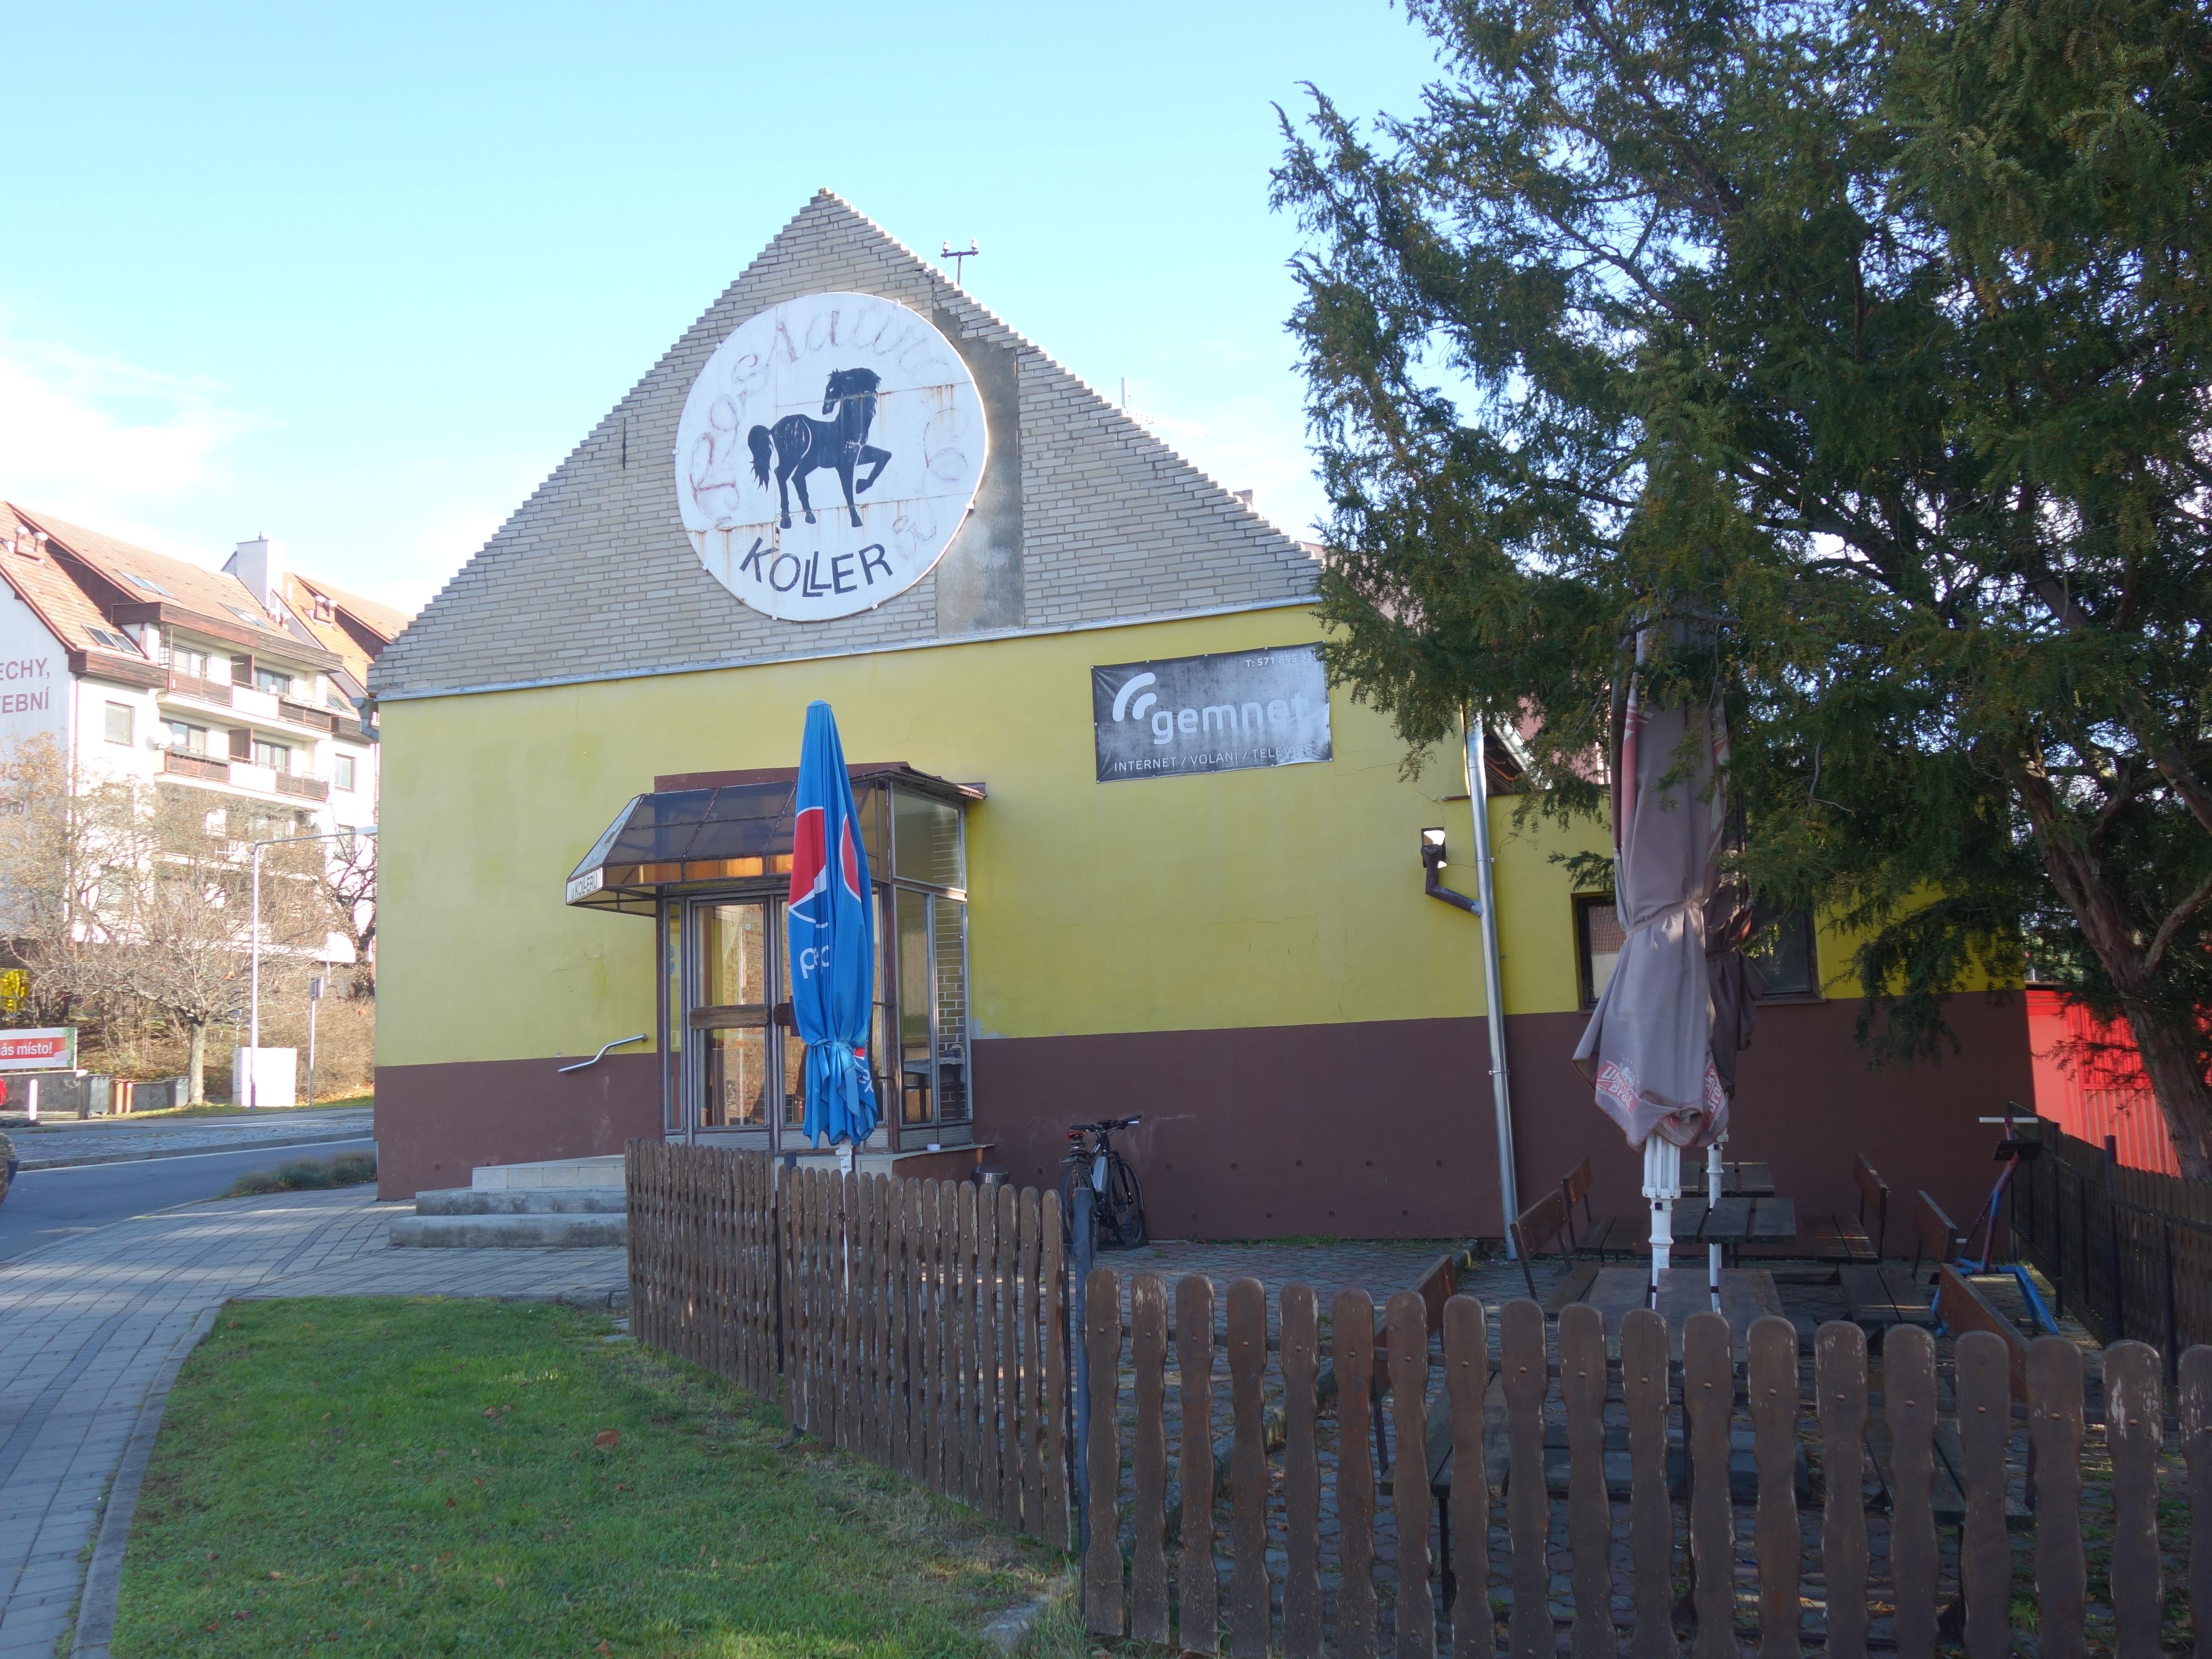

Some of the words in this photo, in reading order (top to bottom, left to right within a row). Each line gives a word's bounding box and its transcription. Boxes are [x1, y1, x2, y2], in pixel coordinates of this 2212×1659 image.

[739, 536, 893, 598] KOLLER
[1258, 656, 1274, 666] 571
[1279, 655, 1297, 664] 895
[1301, 653, 1317, 662] 32
[0, 686, 50, 713] EBNÍ
[1151, 693, 1311, 745] gemnet
[1114, 757, 1177, 773] INTERNET
[1190, 751, 1238, 765] VOLÁNÍ
[1251, 743, 1313, 759] TELEVIZE
[0, 1042, 14, 1056] ás
[17, 1041, 53, 1055] místo!
